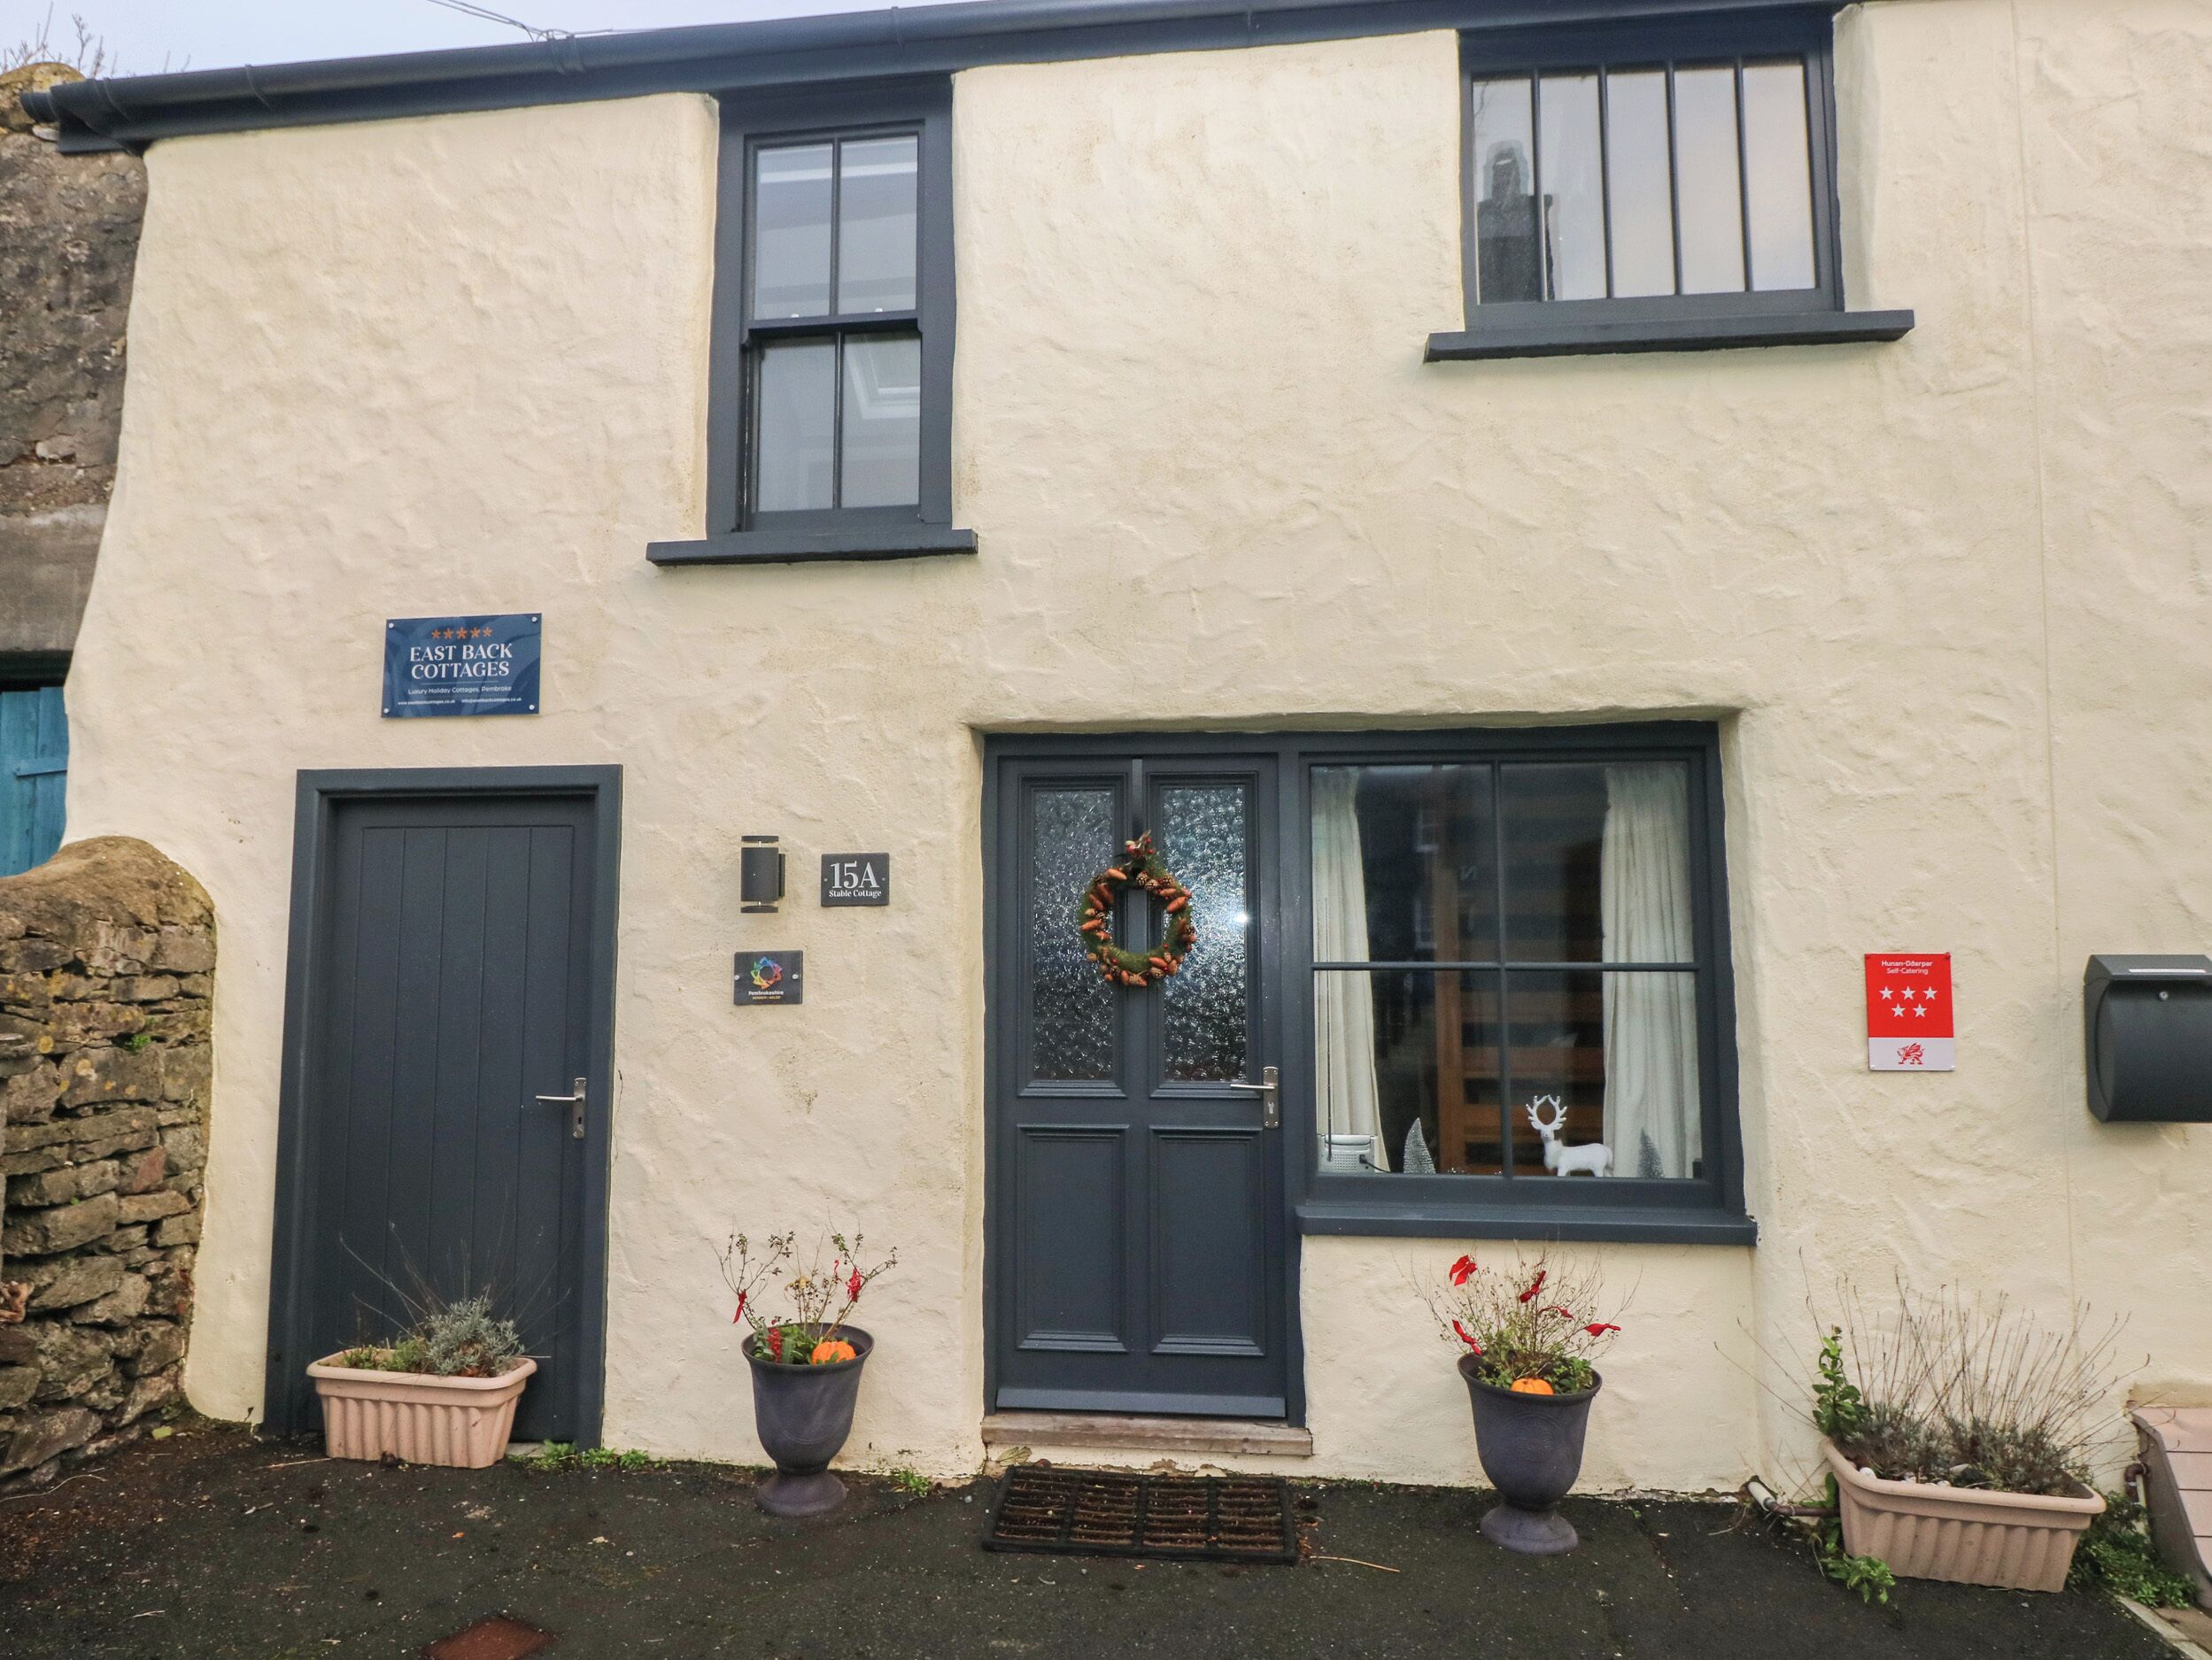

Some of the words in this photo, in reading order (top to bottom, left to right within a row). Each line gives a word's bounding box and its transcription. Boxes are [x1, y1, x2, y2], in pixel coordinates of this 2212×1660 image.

[410, 645, 457, 662] EAST
[461, 643, 513, 660] BACK
[411, 661, 510, 679] COTTAGES
[830, 860, 880, 889] 15A
[829, 889, 852, 898] Stable
[853, 889, 882, 899] Cottage
[1886, 967, 1929, 976] Self-Catering
